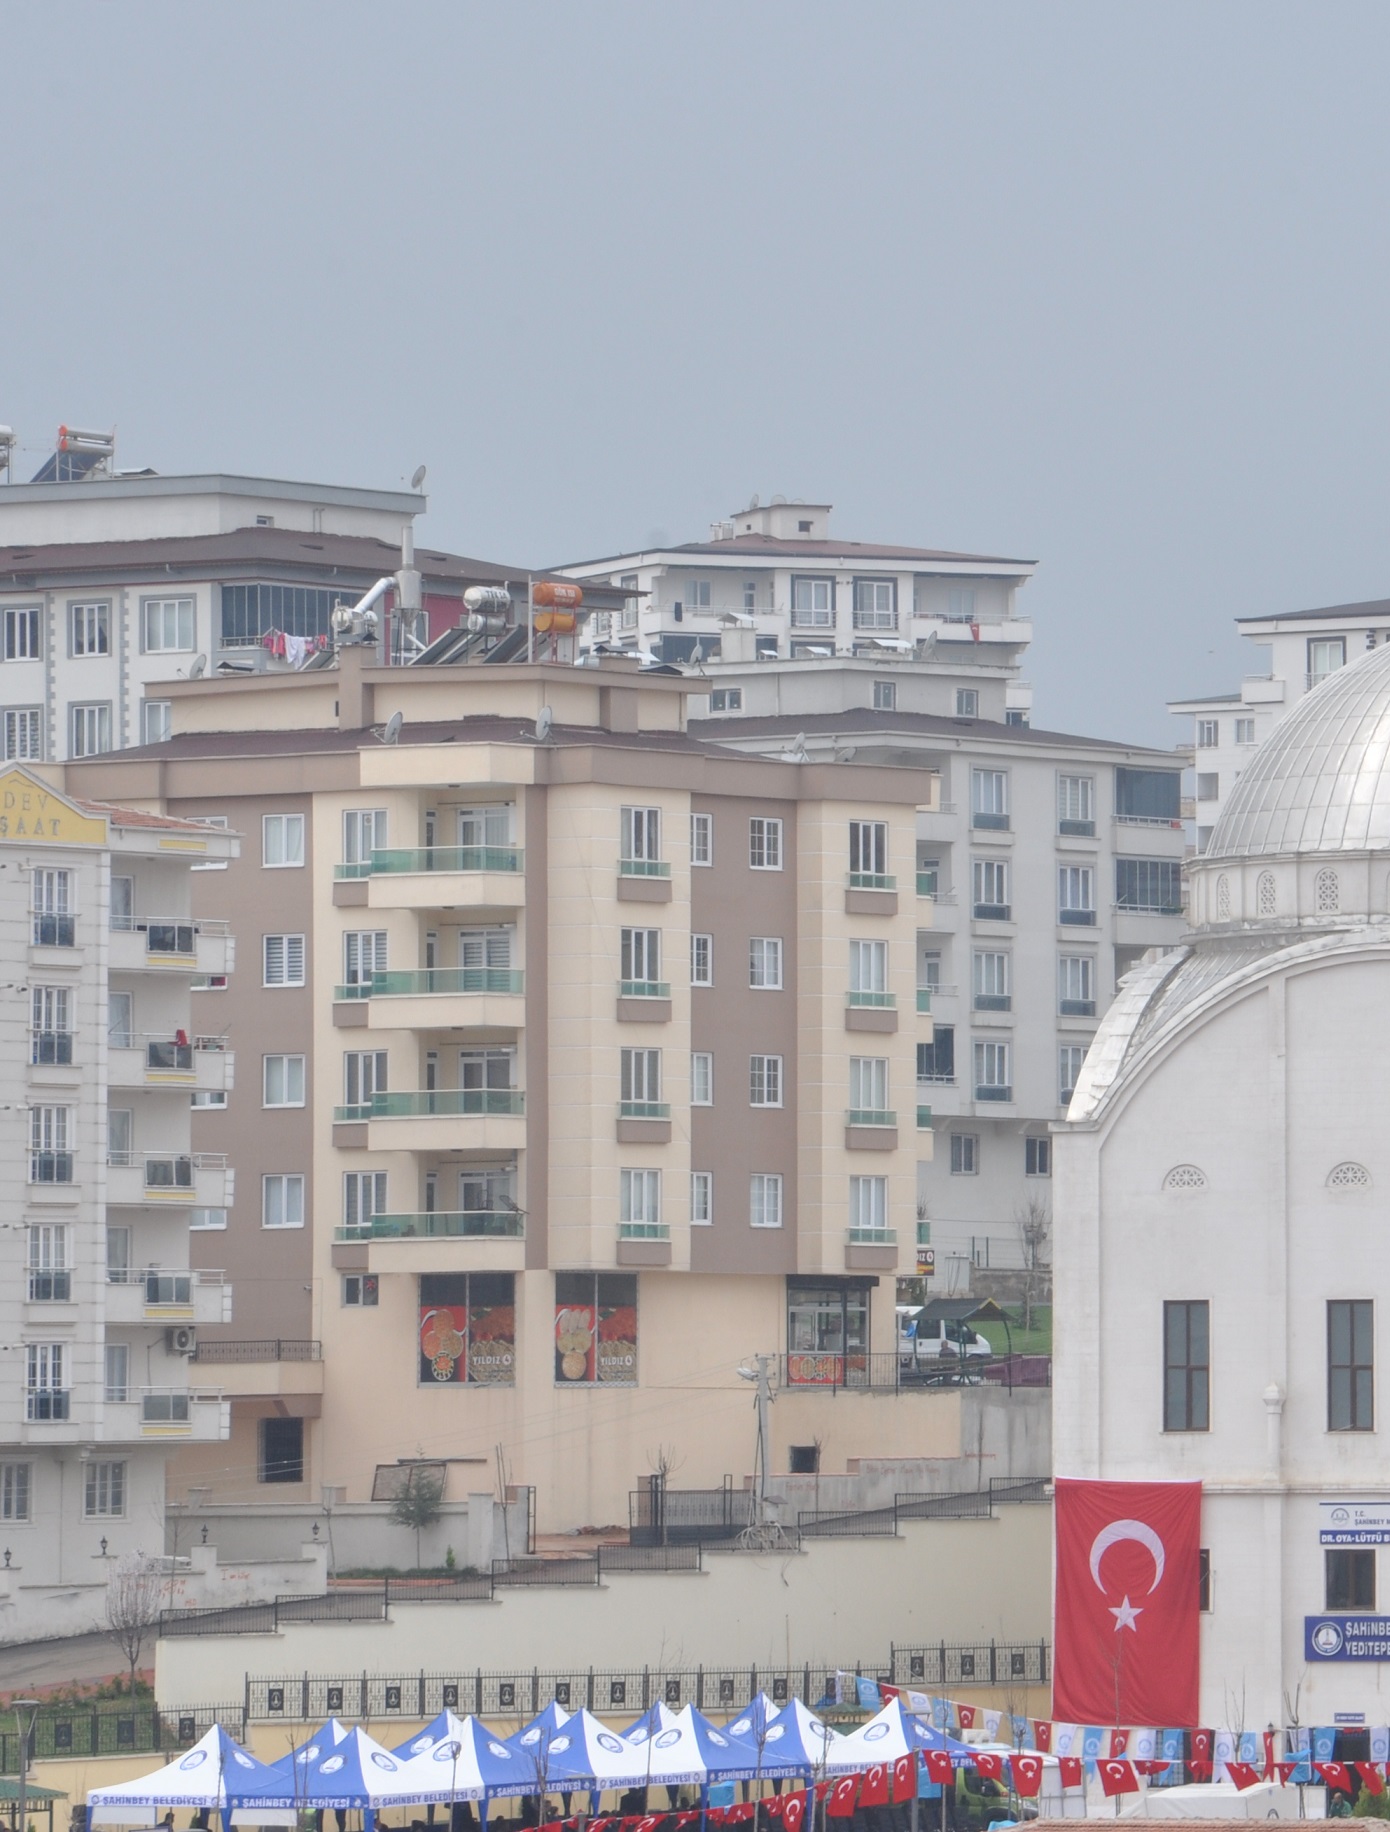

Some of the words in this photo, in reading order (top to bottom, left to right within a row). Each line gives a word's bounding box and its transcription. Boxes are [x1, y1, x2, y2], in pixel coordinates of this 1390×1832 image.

[473, 1356, 500, 1365] YILDIZ
[601, 1356, 624, 1365] YILDIZ
[1354, 1517, 1385, 1526] ŞAHİNBEY
[1321, 1534, 1335, 1543] DR.
[823, 1763, 858, 1774] AHİNBEY
[609, 1777, 646, 1789] ŞAHİNBEY
[648, 1772, 691, 1785] BELEDİYESİ
[717, 1769, 753, 1781] ŞAHİNBEY
[496, 1784, 536, 1798] ŞAHİNBEY
[537, 1779, 582, 1793] BLEDİYESİ
[102, 1794, 150, 1806] ŞAHİNBEY
[152, 1794, 207, 1806] BELEDİYESİ
[242, 1796, 292, 1809] ŞAHİNBEY
[382, 1794, 421, 1807] ŞAHİNBEY
